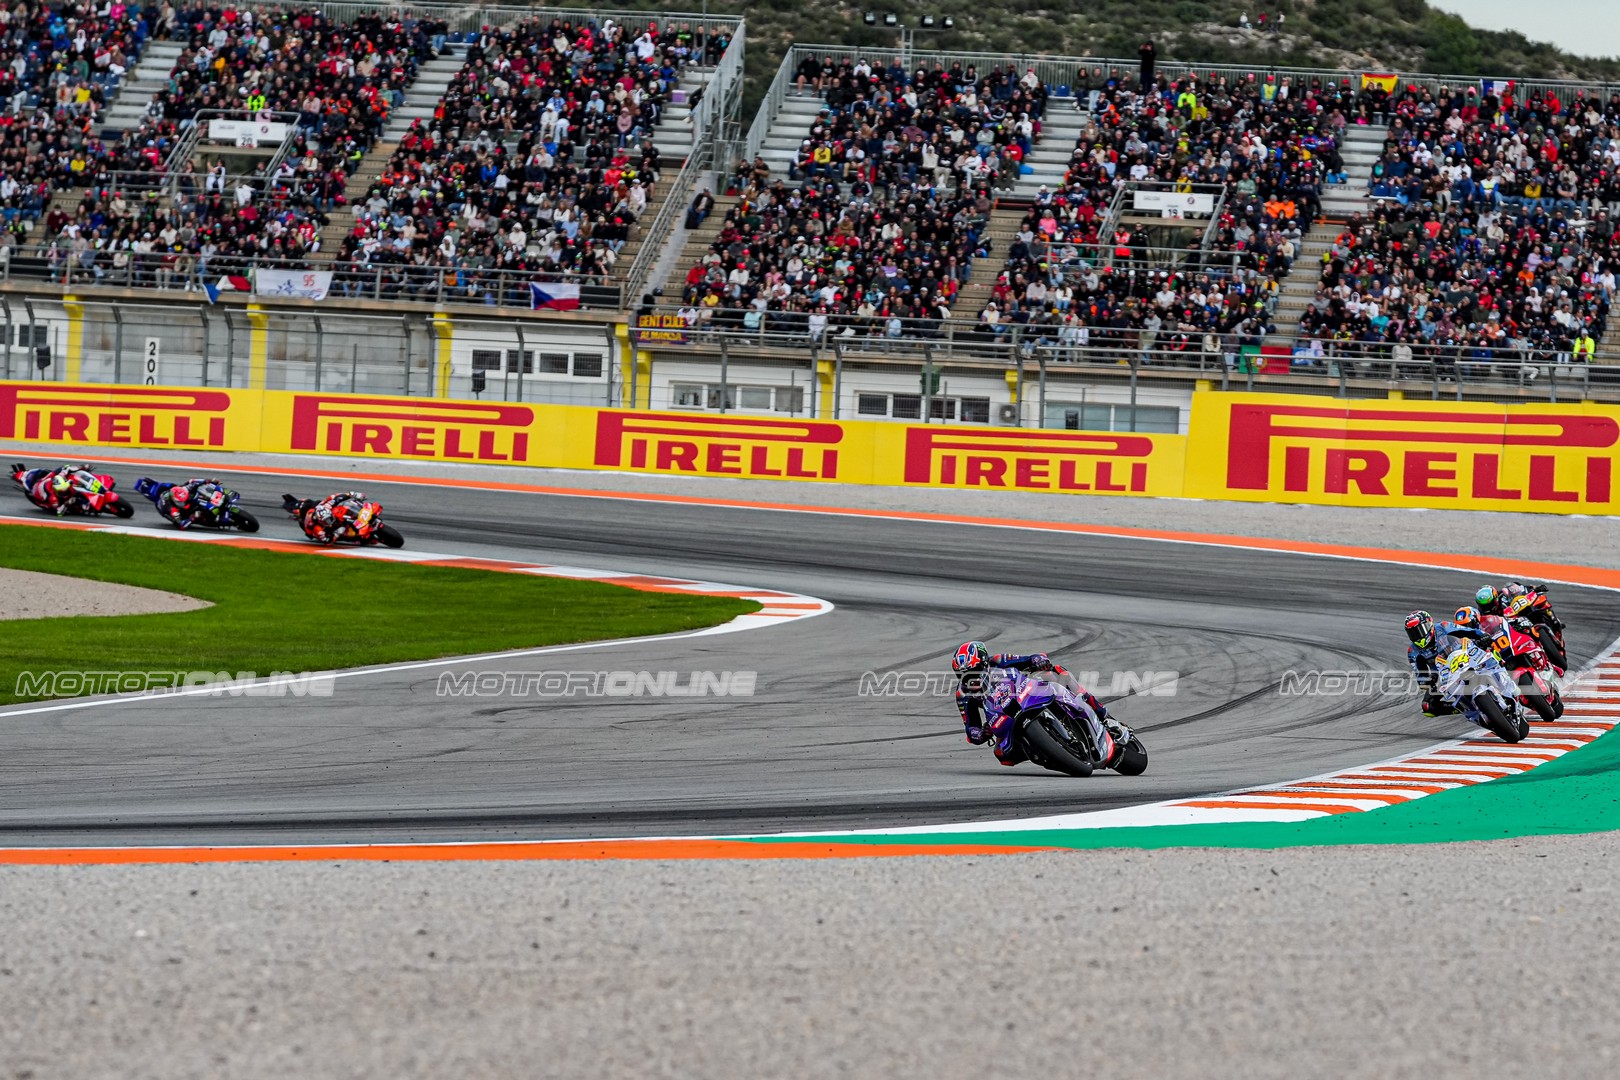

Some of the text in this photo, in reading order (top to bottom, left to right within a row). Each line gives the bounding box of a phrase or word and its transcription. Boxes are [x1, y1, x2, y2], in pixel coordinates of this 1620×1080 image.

[0, 384, 230, 446] PIRELLI
[290, 395, 534, 461] PIRELLI
[594, 410, 844, 479] PIRELLI
[904, 427, 1153, 492] PIRELLI
[1226, 403, 1620, 503] PIRELLI
[1512, 597, 1528, 612] 33
[1450, 653, 1470, 674] 54
